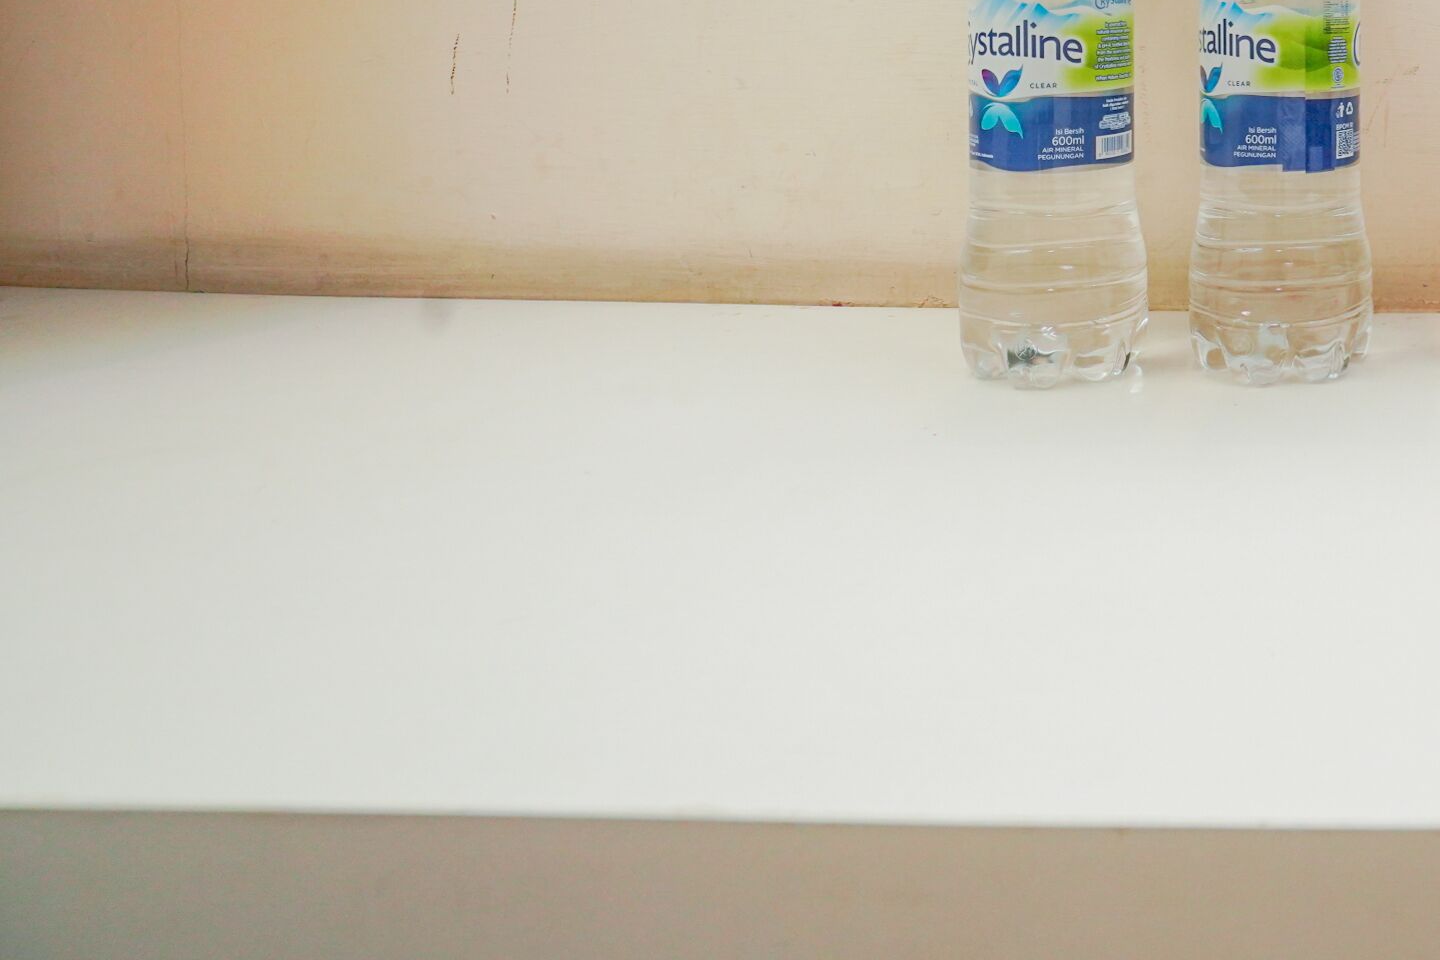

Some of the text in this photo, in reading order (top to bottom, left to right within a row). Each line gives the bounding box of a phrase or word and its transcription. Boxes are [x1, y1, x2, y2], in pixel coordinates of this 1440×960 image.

[969, 19, 1083, 65] ystalline
[1199, 18, 1276, 64] talline
[1052, 136, 1085, 146] 600ml
[1245, 135, 1277, 145] 600ml
[1248, 144, 1276, 152] MINERAL
[1037, 153, 1084, 161] PEGUNUNGAN
[1233, 151, 1277, 159] PEGUNUNGAN
